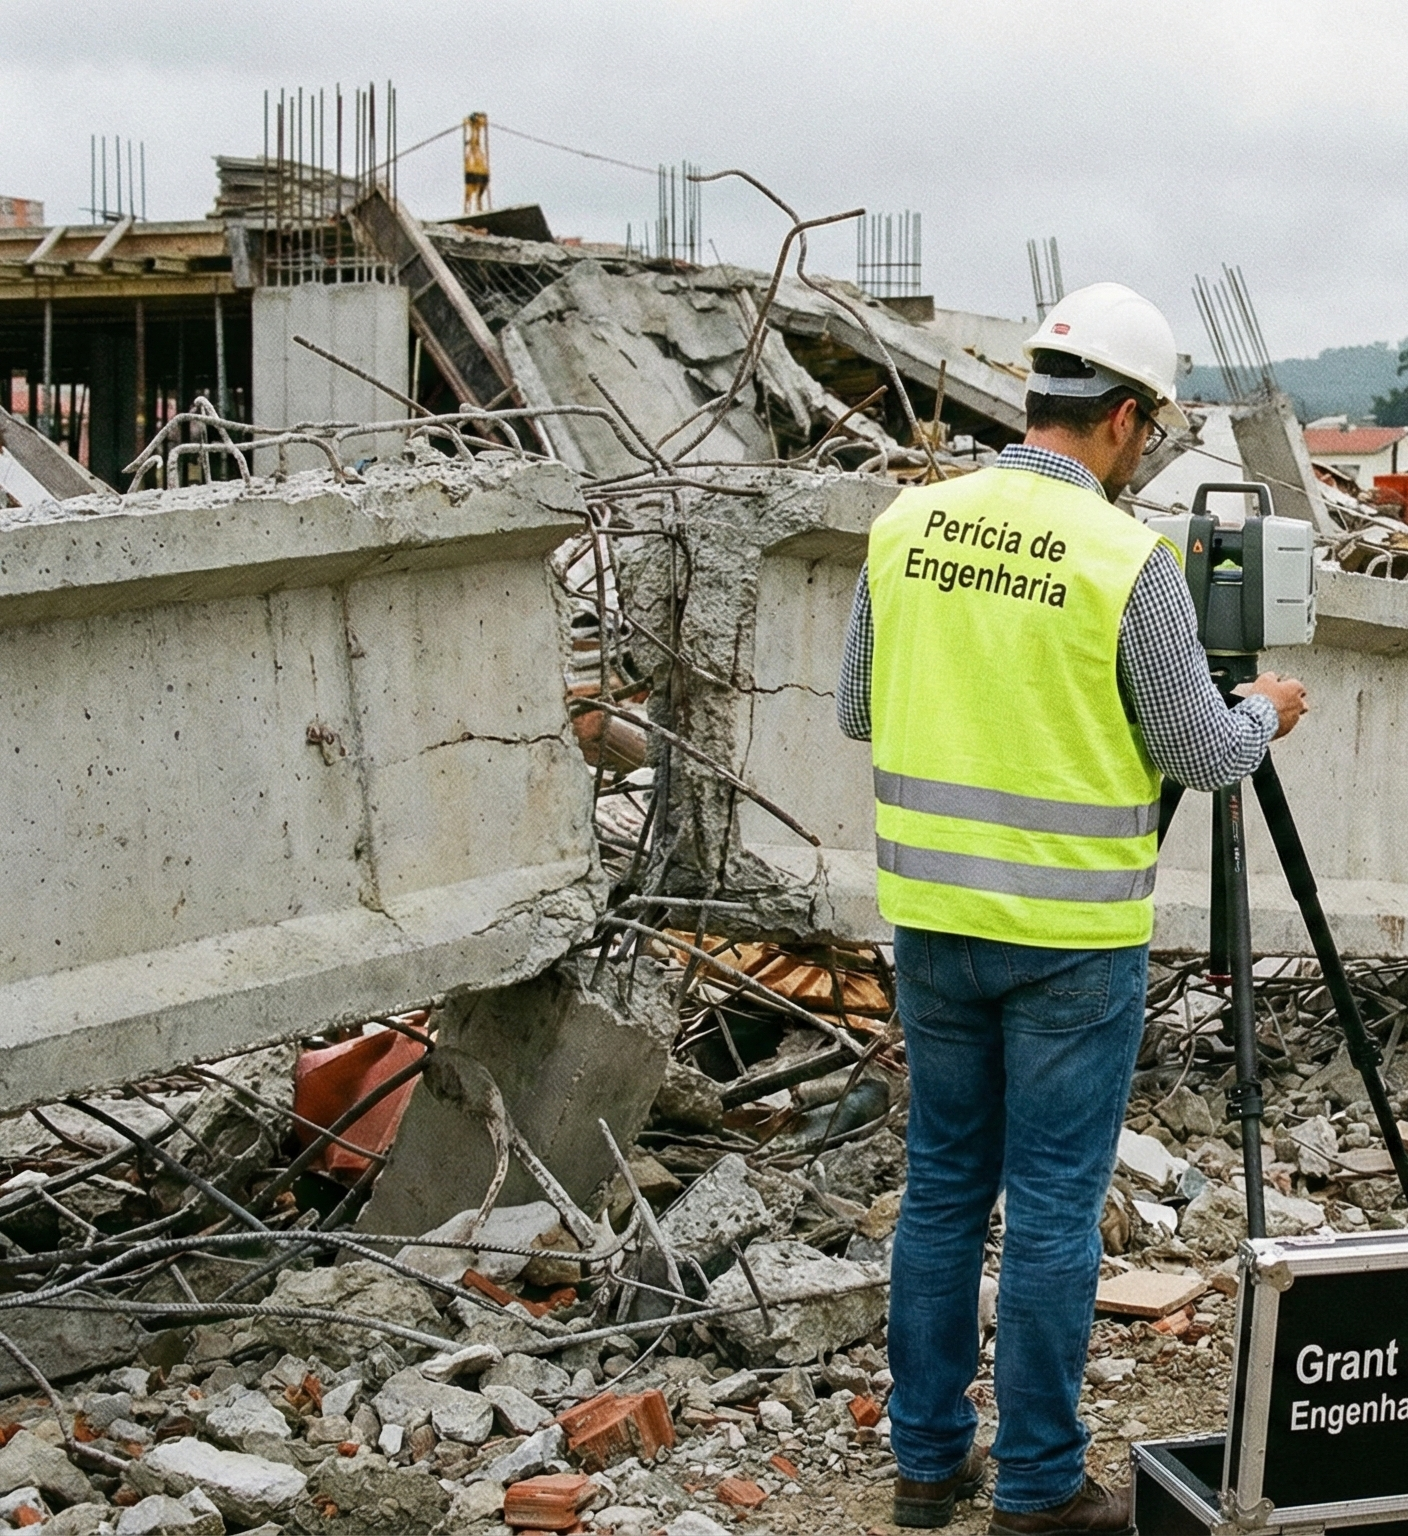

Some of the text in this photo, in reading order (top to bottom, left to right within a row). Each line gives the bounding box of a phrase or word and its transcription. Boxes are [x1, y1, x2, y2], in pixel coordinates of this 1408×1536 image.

[924, 510, 1066, 562] Perícia de
[905, 548, 1067, 608] Engenharia
[1296, 1339, 1398, 1384] Grant
